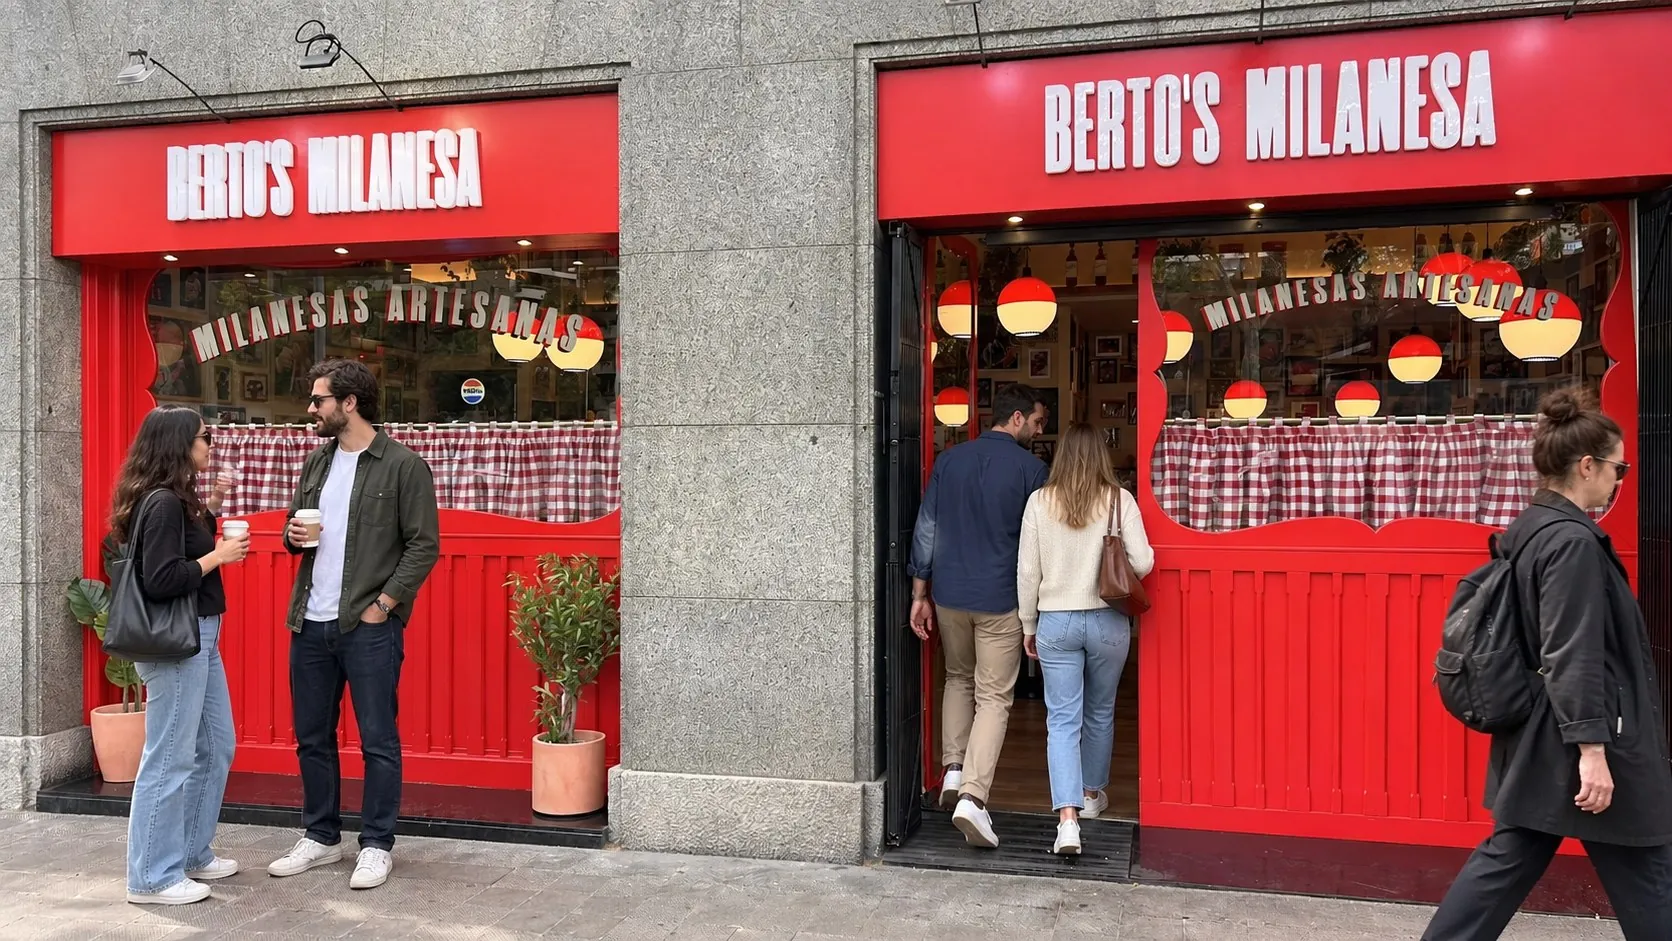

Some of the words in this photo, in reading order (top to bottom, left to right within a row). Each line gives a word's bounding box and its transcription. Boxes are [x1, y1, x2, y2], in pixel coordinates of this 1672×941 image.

[1045, 71, 1221, 174] BERTO'S
[1245, 50, 1497, 161] MILANESA
[167, 139, 294, 222] BERTO'S
[307, 128, 483, 214] MILANESA
[188, 285, 370, 364] MILANESAS
[385, 284, 584, 352] ARTESANAS
[1200, 272, 1366, 332] MILANESAS
[1381, 271, 1559, 320] ARTESANAS
